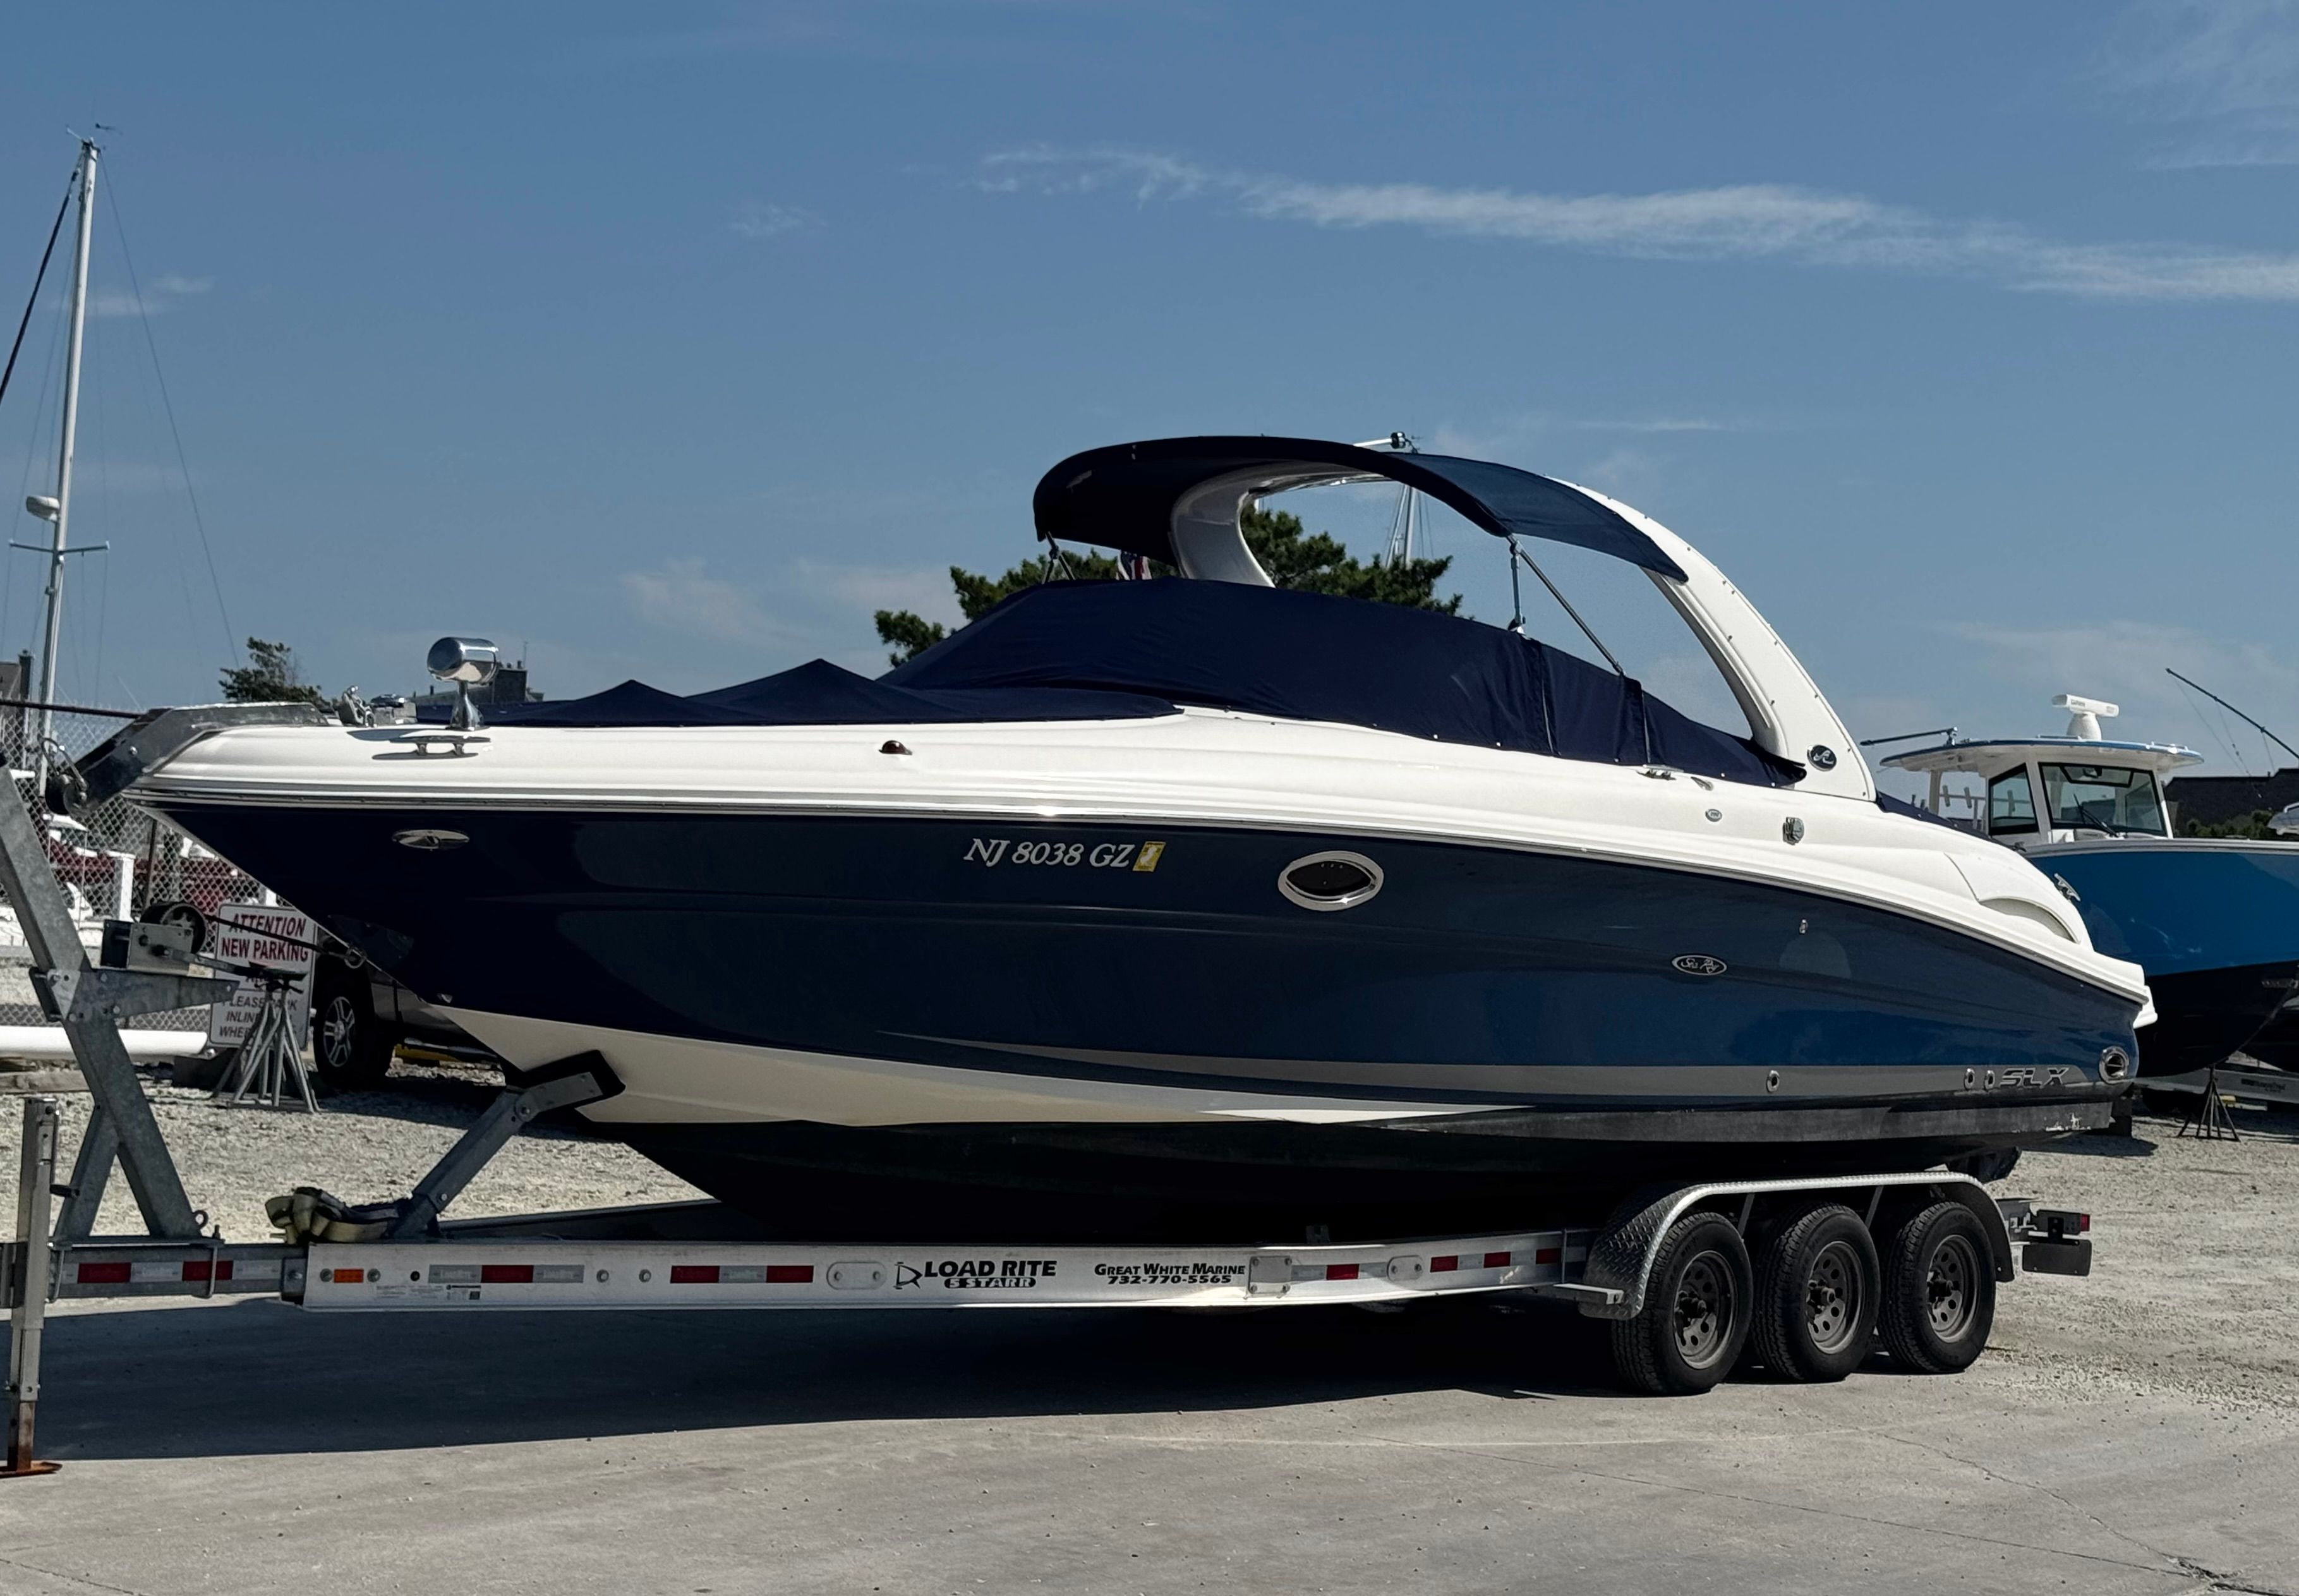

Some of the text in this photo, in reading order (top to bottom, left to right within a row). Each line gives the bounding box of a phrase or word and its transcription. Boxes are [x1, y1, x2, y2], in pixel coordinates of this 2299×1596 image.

[963, 838, 1135, 868] NJ 8038 GZ
[229, 914, 306, 937] ATTENTION
[222, 938, 308, 962] NEW PARKING
[2000, 1067, 2068, 1087] SLX
[924, 1260, 1058, 1278] LOAD RITE
[949, 1278, 1032, 1288] 5 STARR
[1107, 1274, 1232, 1285] 732-770-5565
